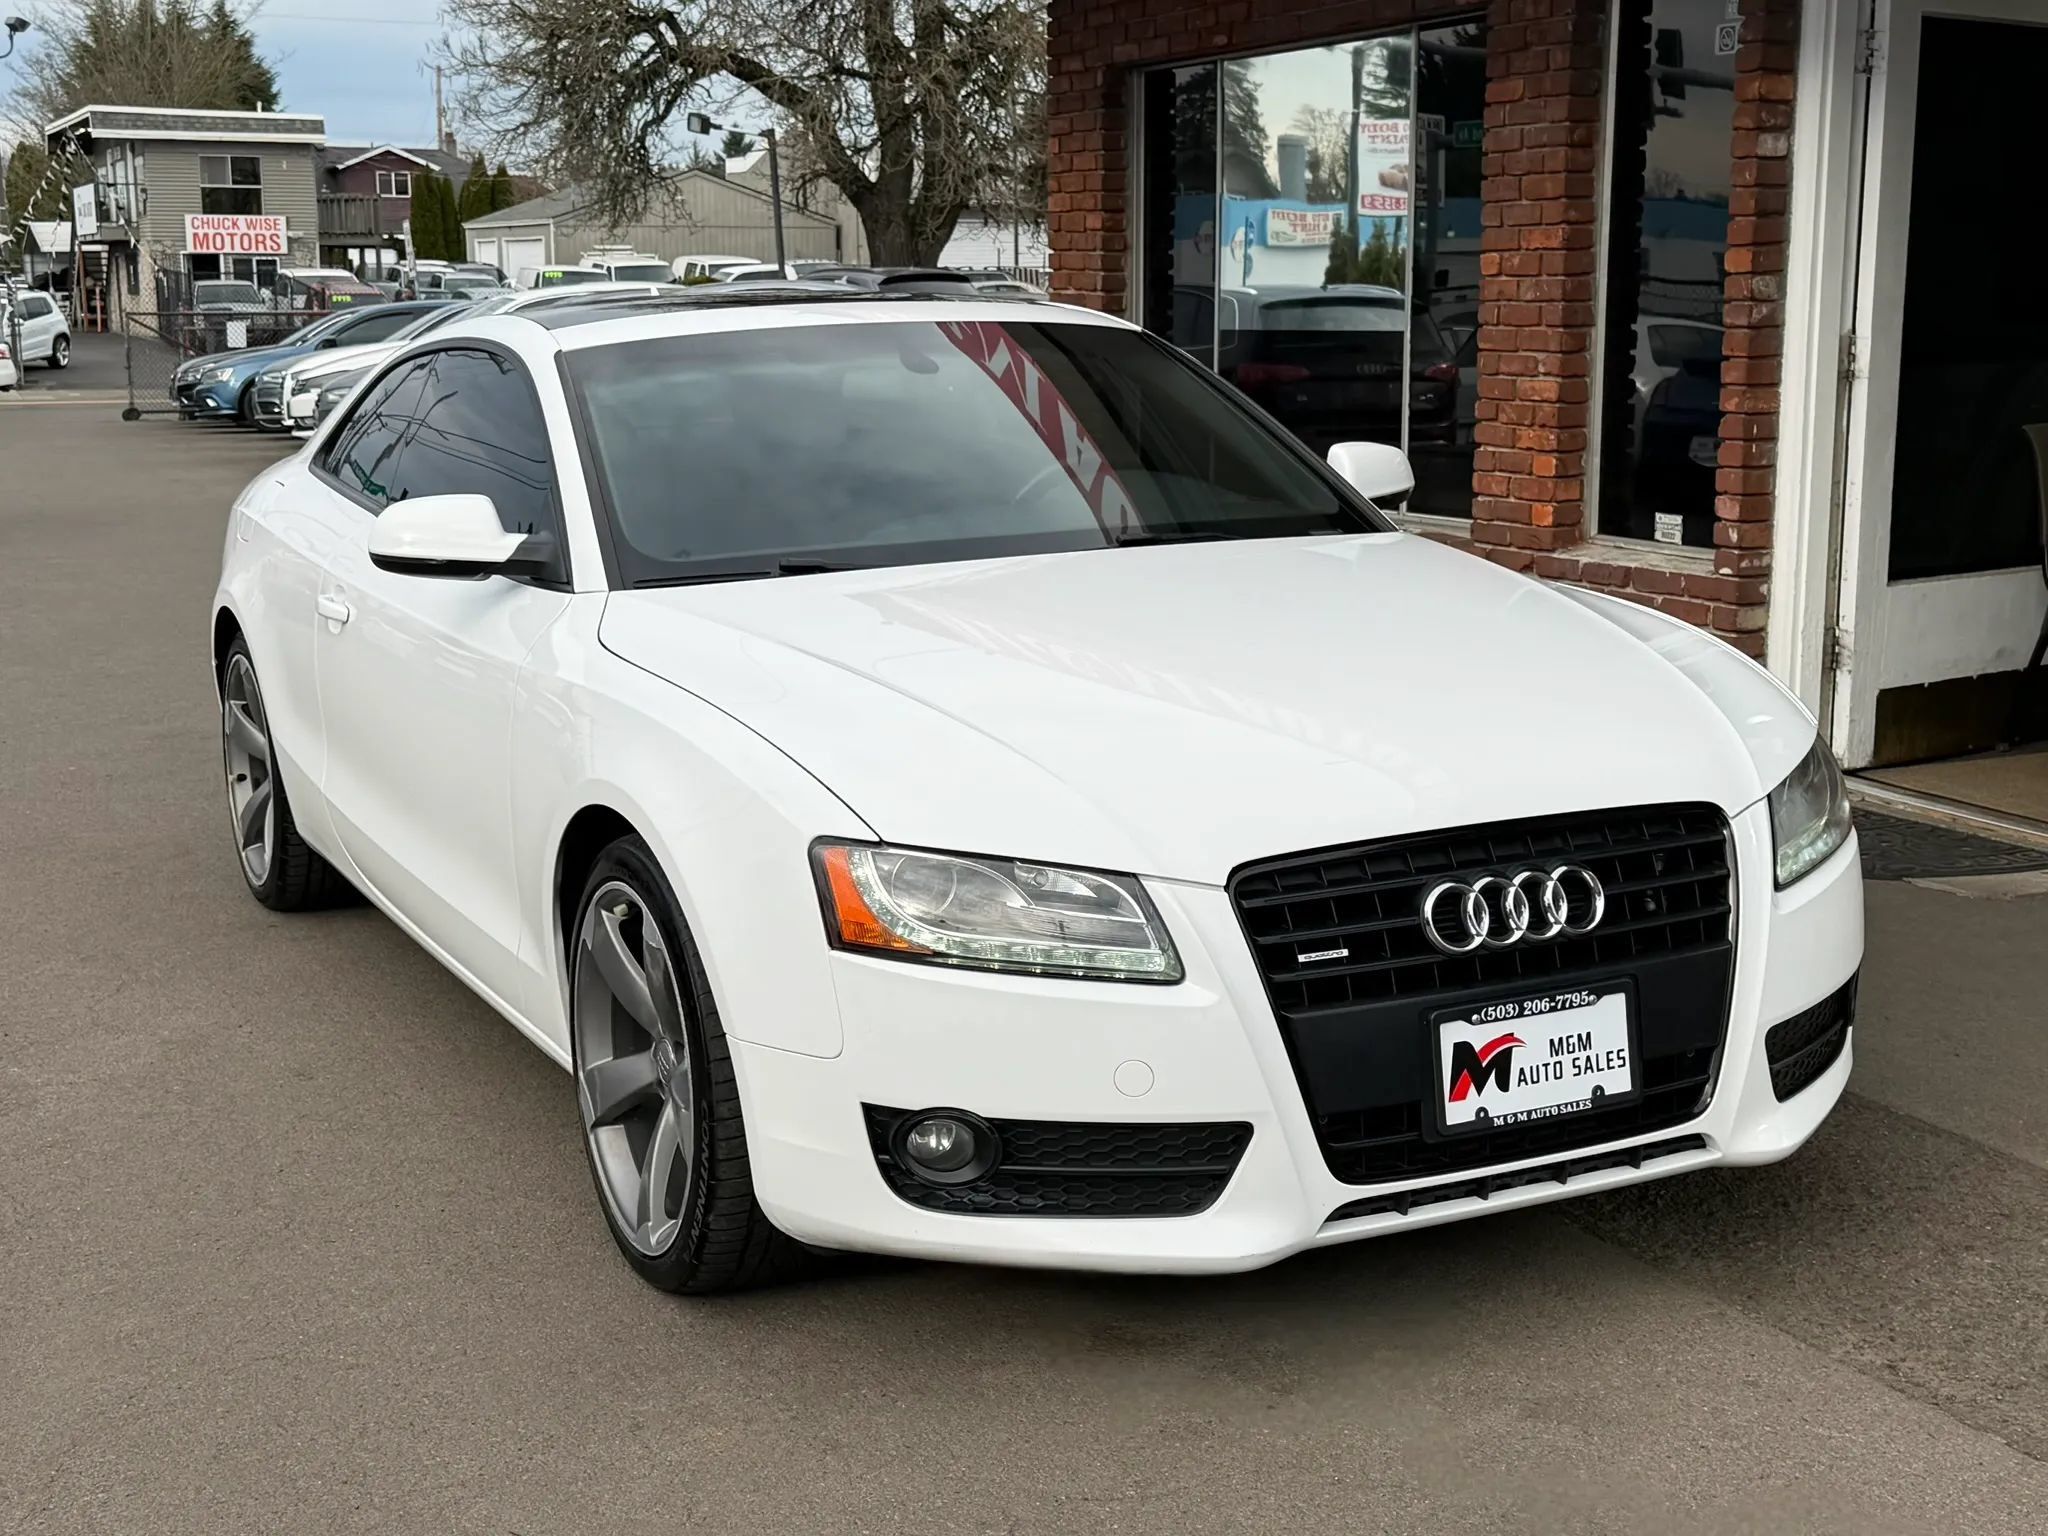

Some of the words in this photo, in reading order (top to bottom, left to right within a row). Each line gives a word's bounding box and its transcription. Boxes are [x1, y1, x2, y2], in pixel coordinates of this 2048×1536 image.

[191, 216, 240, 231] CHUCK
[245, 218, 281, 231] WISE
[192, 232, 282, 252] MOTORS
[1481, 1003, 1519, 1021] (503)
[1523, 990, 1589, 1015] 206-7795
[1549, 1031, 1593, 1058] M&M
[1517, 1060, 1563, 1087] AUTO
[1572, 1048, 1626, 1076] SALES
[1493, 1116, 1505, 1127] M
[1517, 1111, 1528, 1122] M
[1530, 1105, 1559, 1120] AUTO
[1560, 1099, 1592, 1114] SALES
